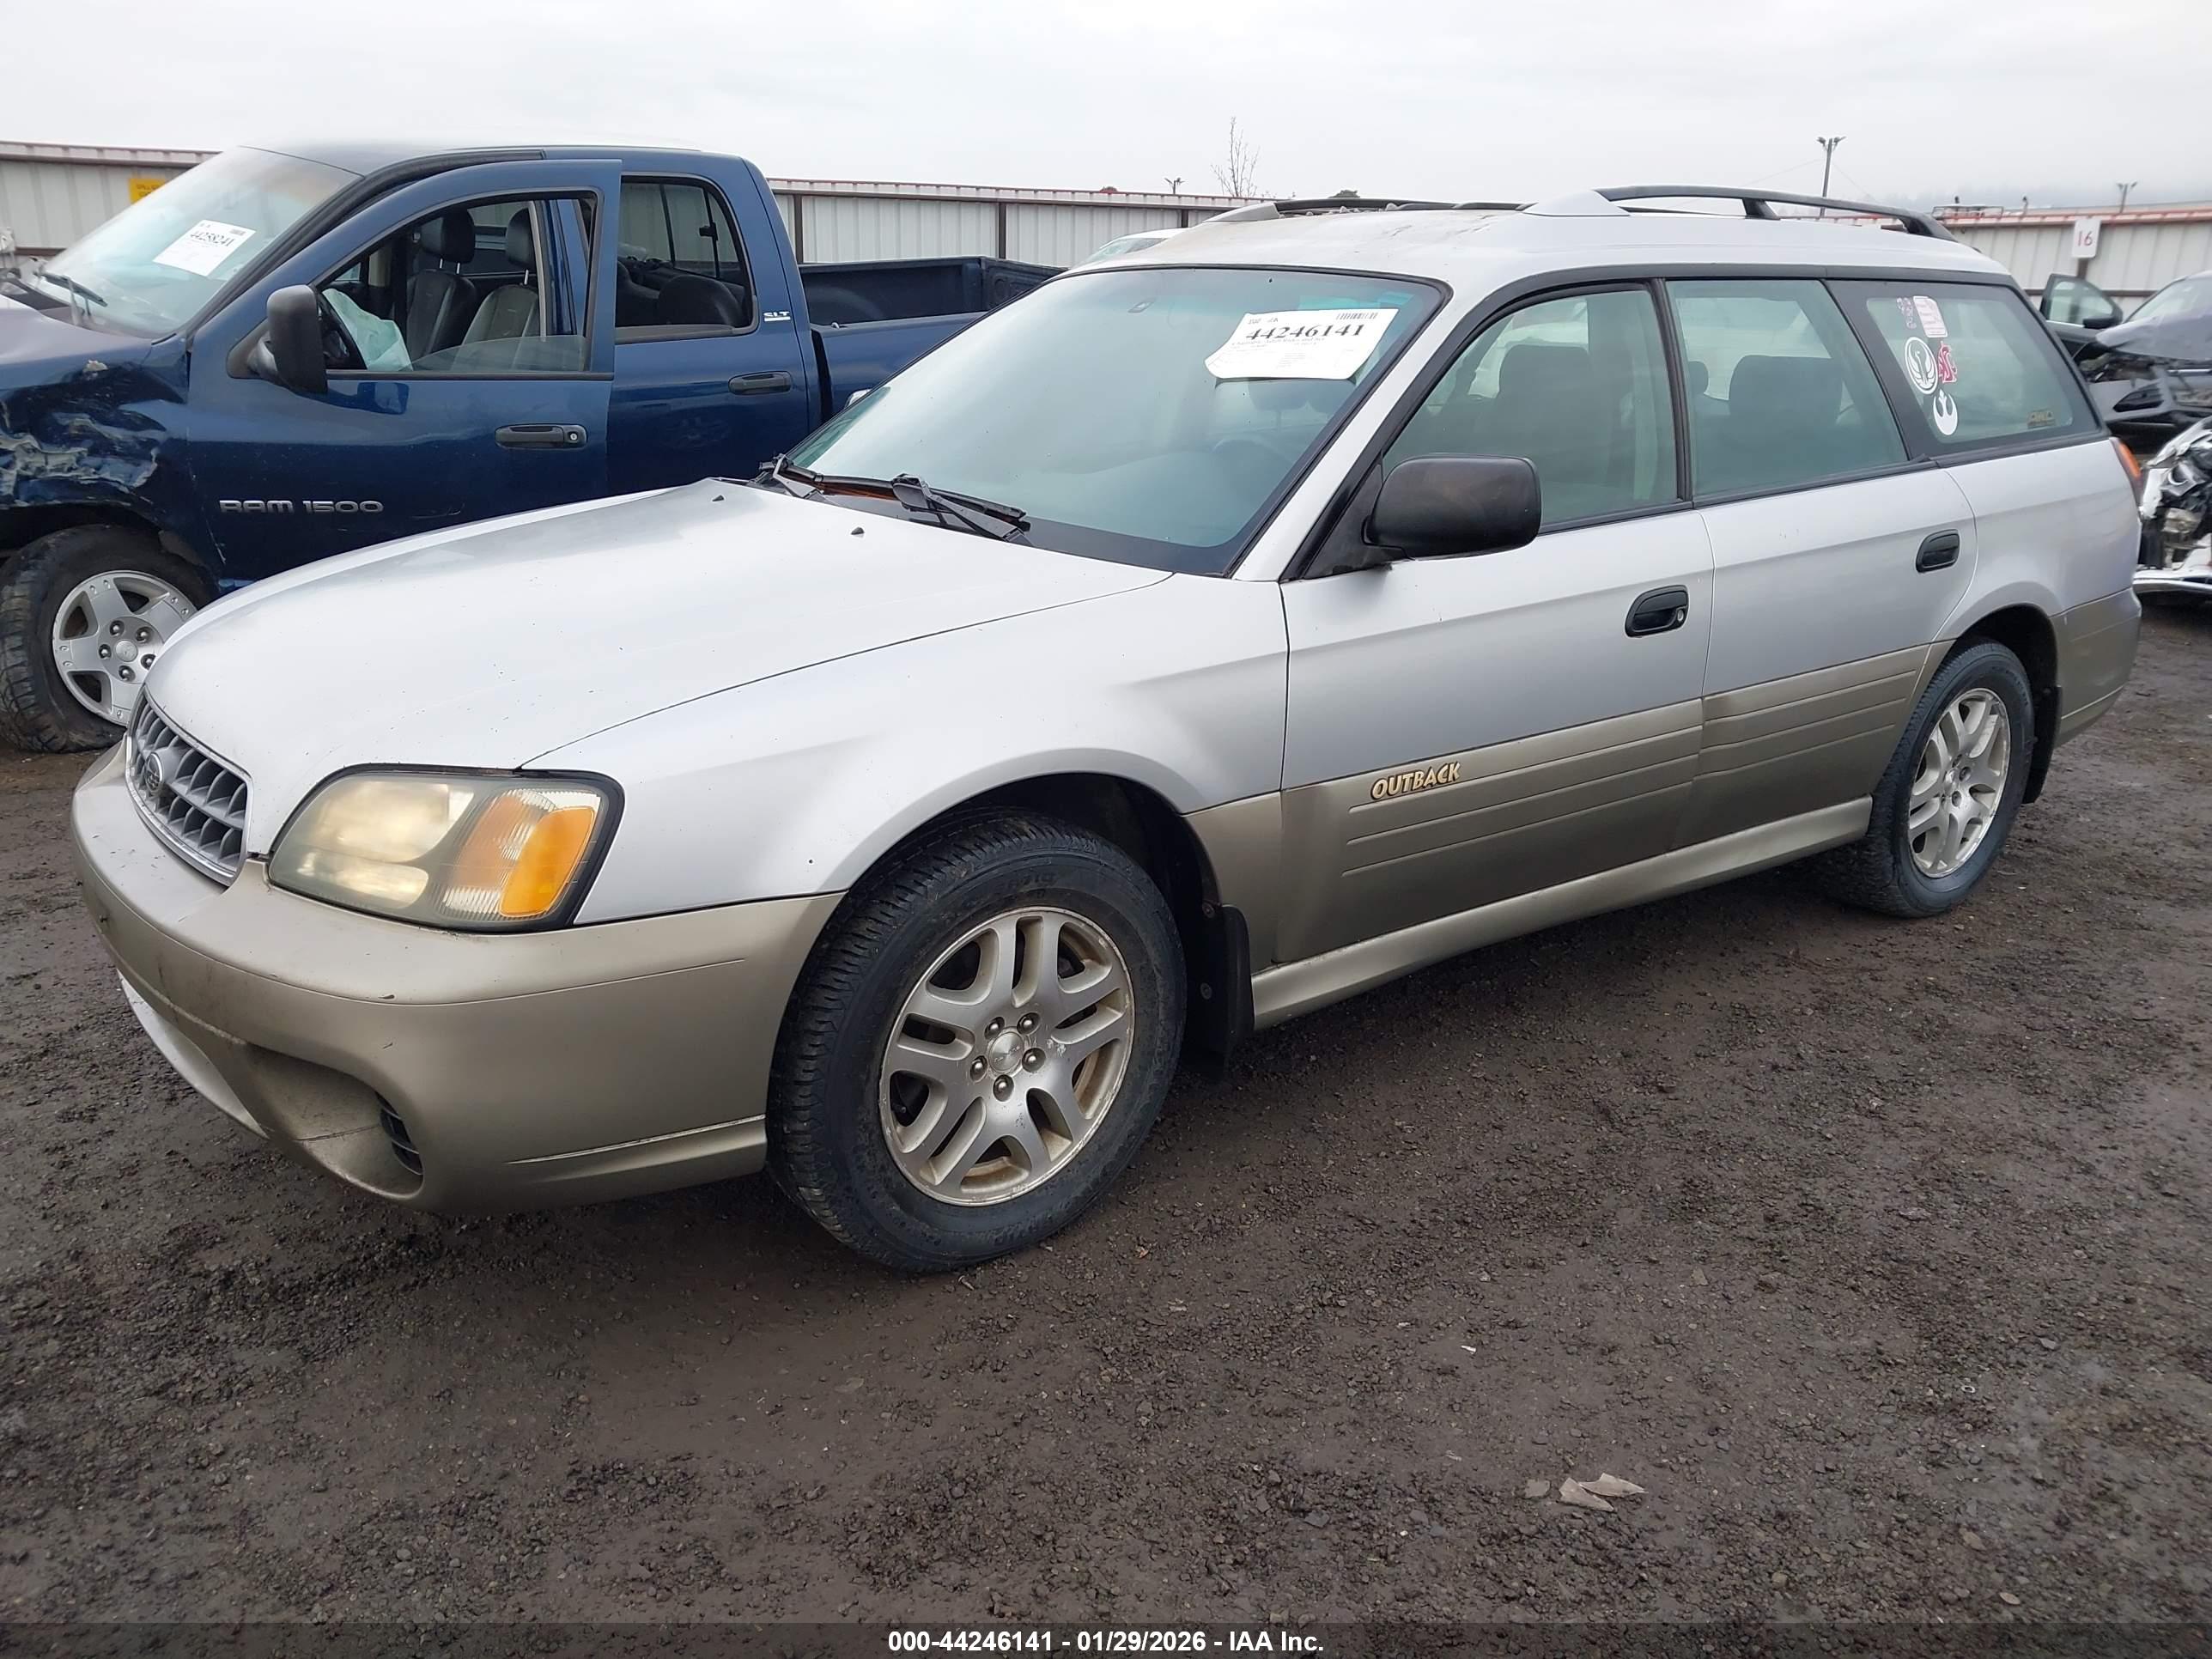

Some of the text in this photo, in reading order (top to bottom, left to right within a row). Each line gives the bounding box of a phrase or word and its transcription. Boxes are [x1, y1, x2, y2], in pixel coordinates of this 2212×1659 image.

[2078, 231, 2094, 246] 16
[1246, 324, 1364, 340] 44246141
[220, 500, 384, 514] RAM 1500
[1370, 761, 1461, 799] OUTBACK
